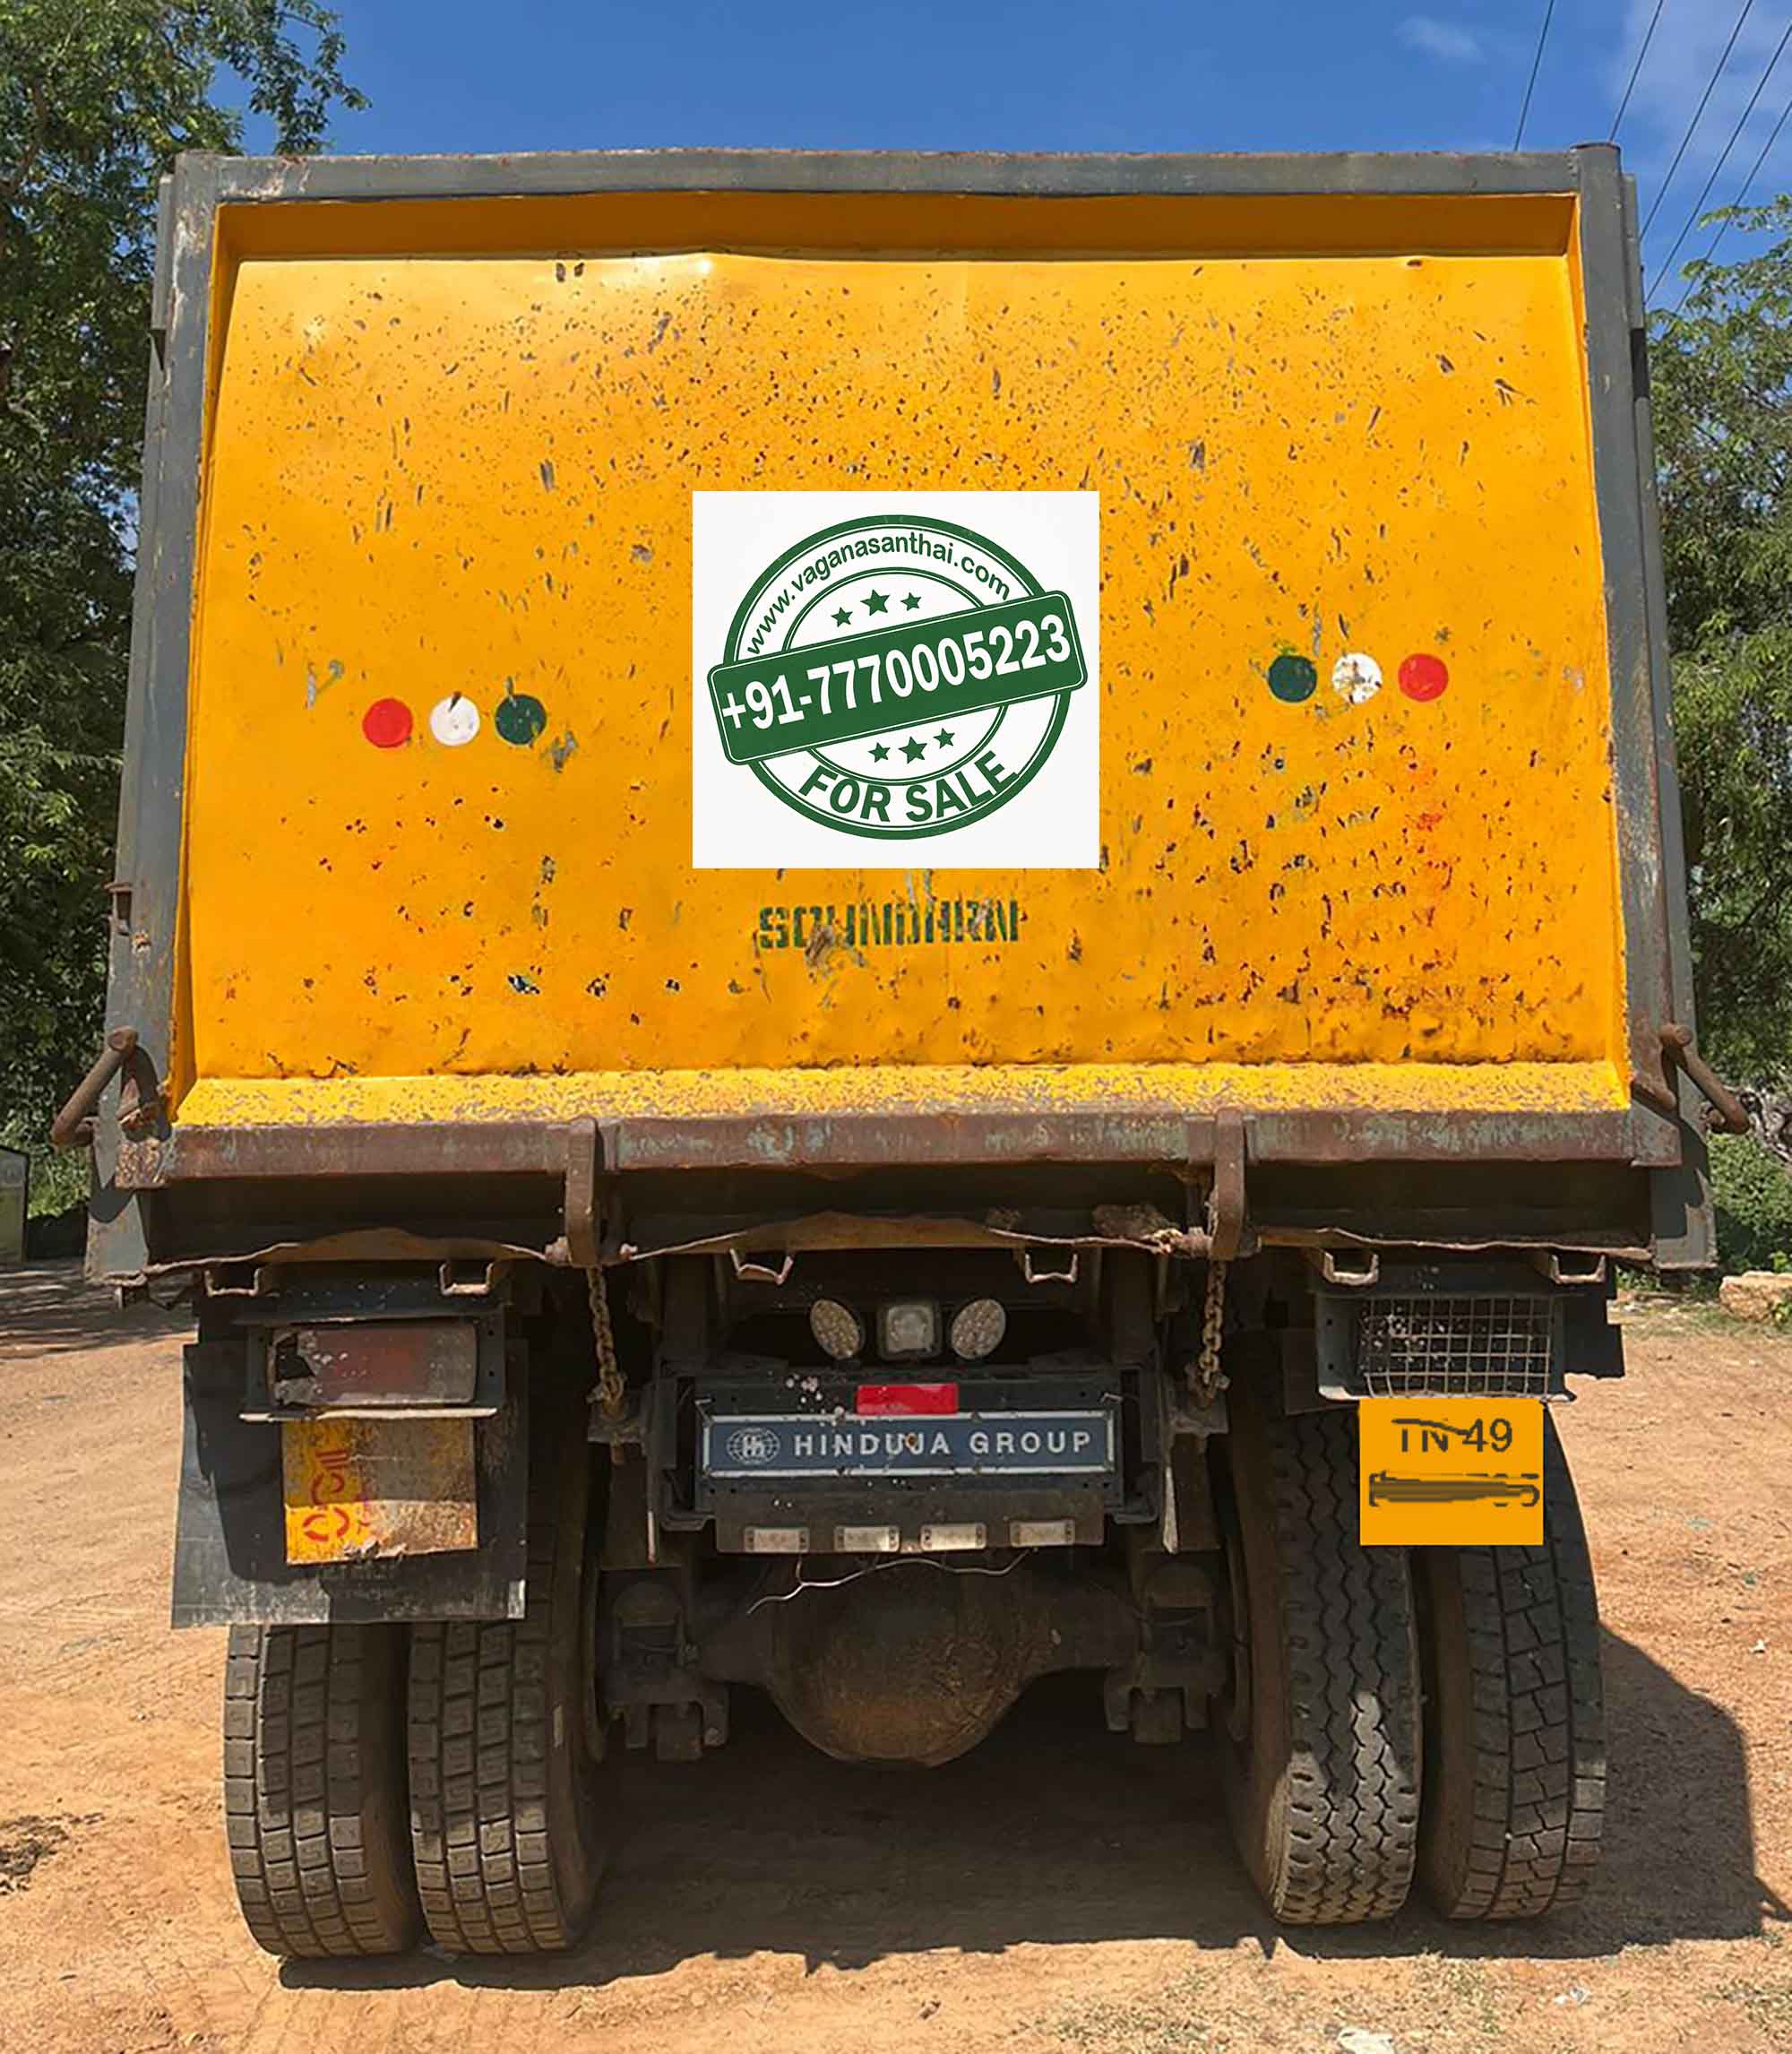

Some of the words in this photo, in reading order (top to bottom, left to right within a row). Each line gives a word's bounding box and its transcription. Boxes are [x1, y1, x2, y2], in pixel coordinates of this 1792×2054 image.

[794, 1434, 951, 1457] HINDUJA
[969, 1431, 1091, 1454] GROUP
[1461, 1418, 1512, 1453] 49
